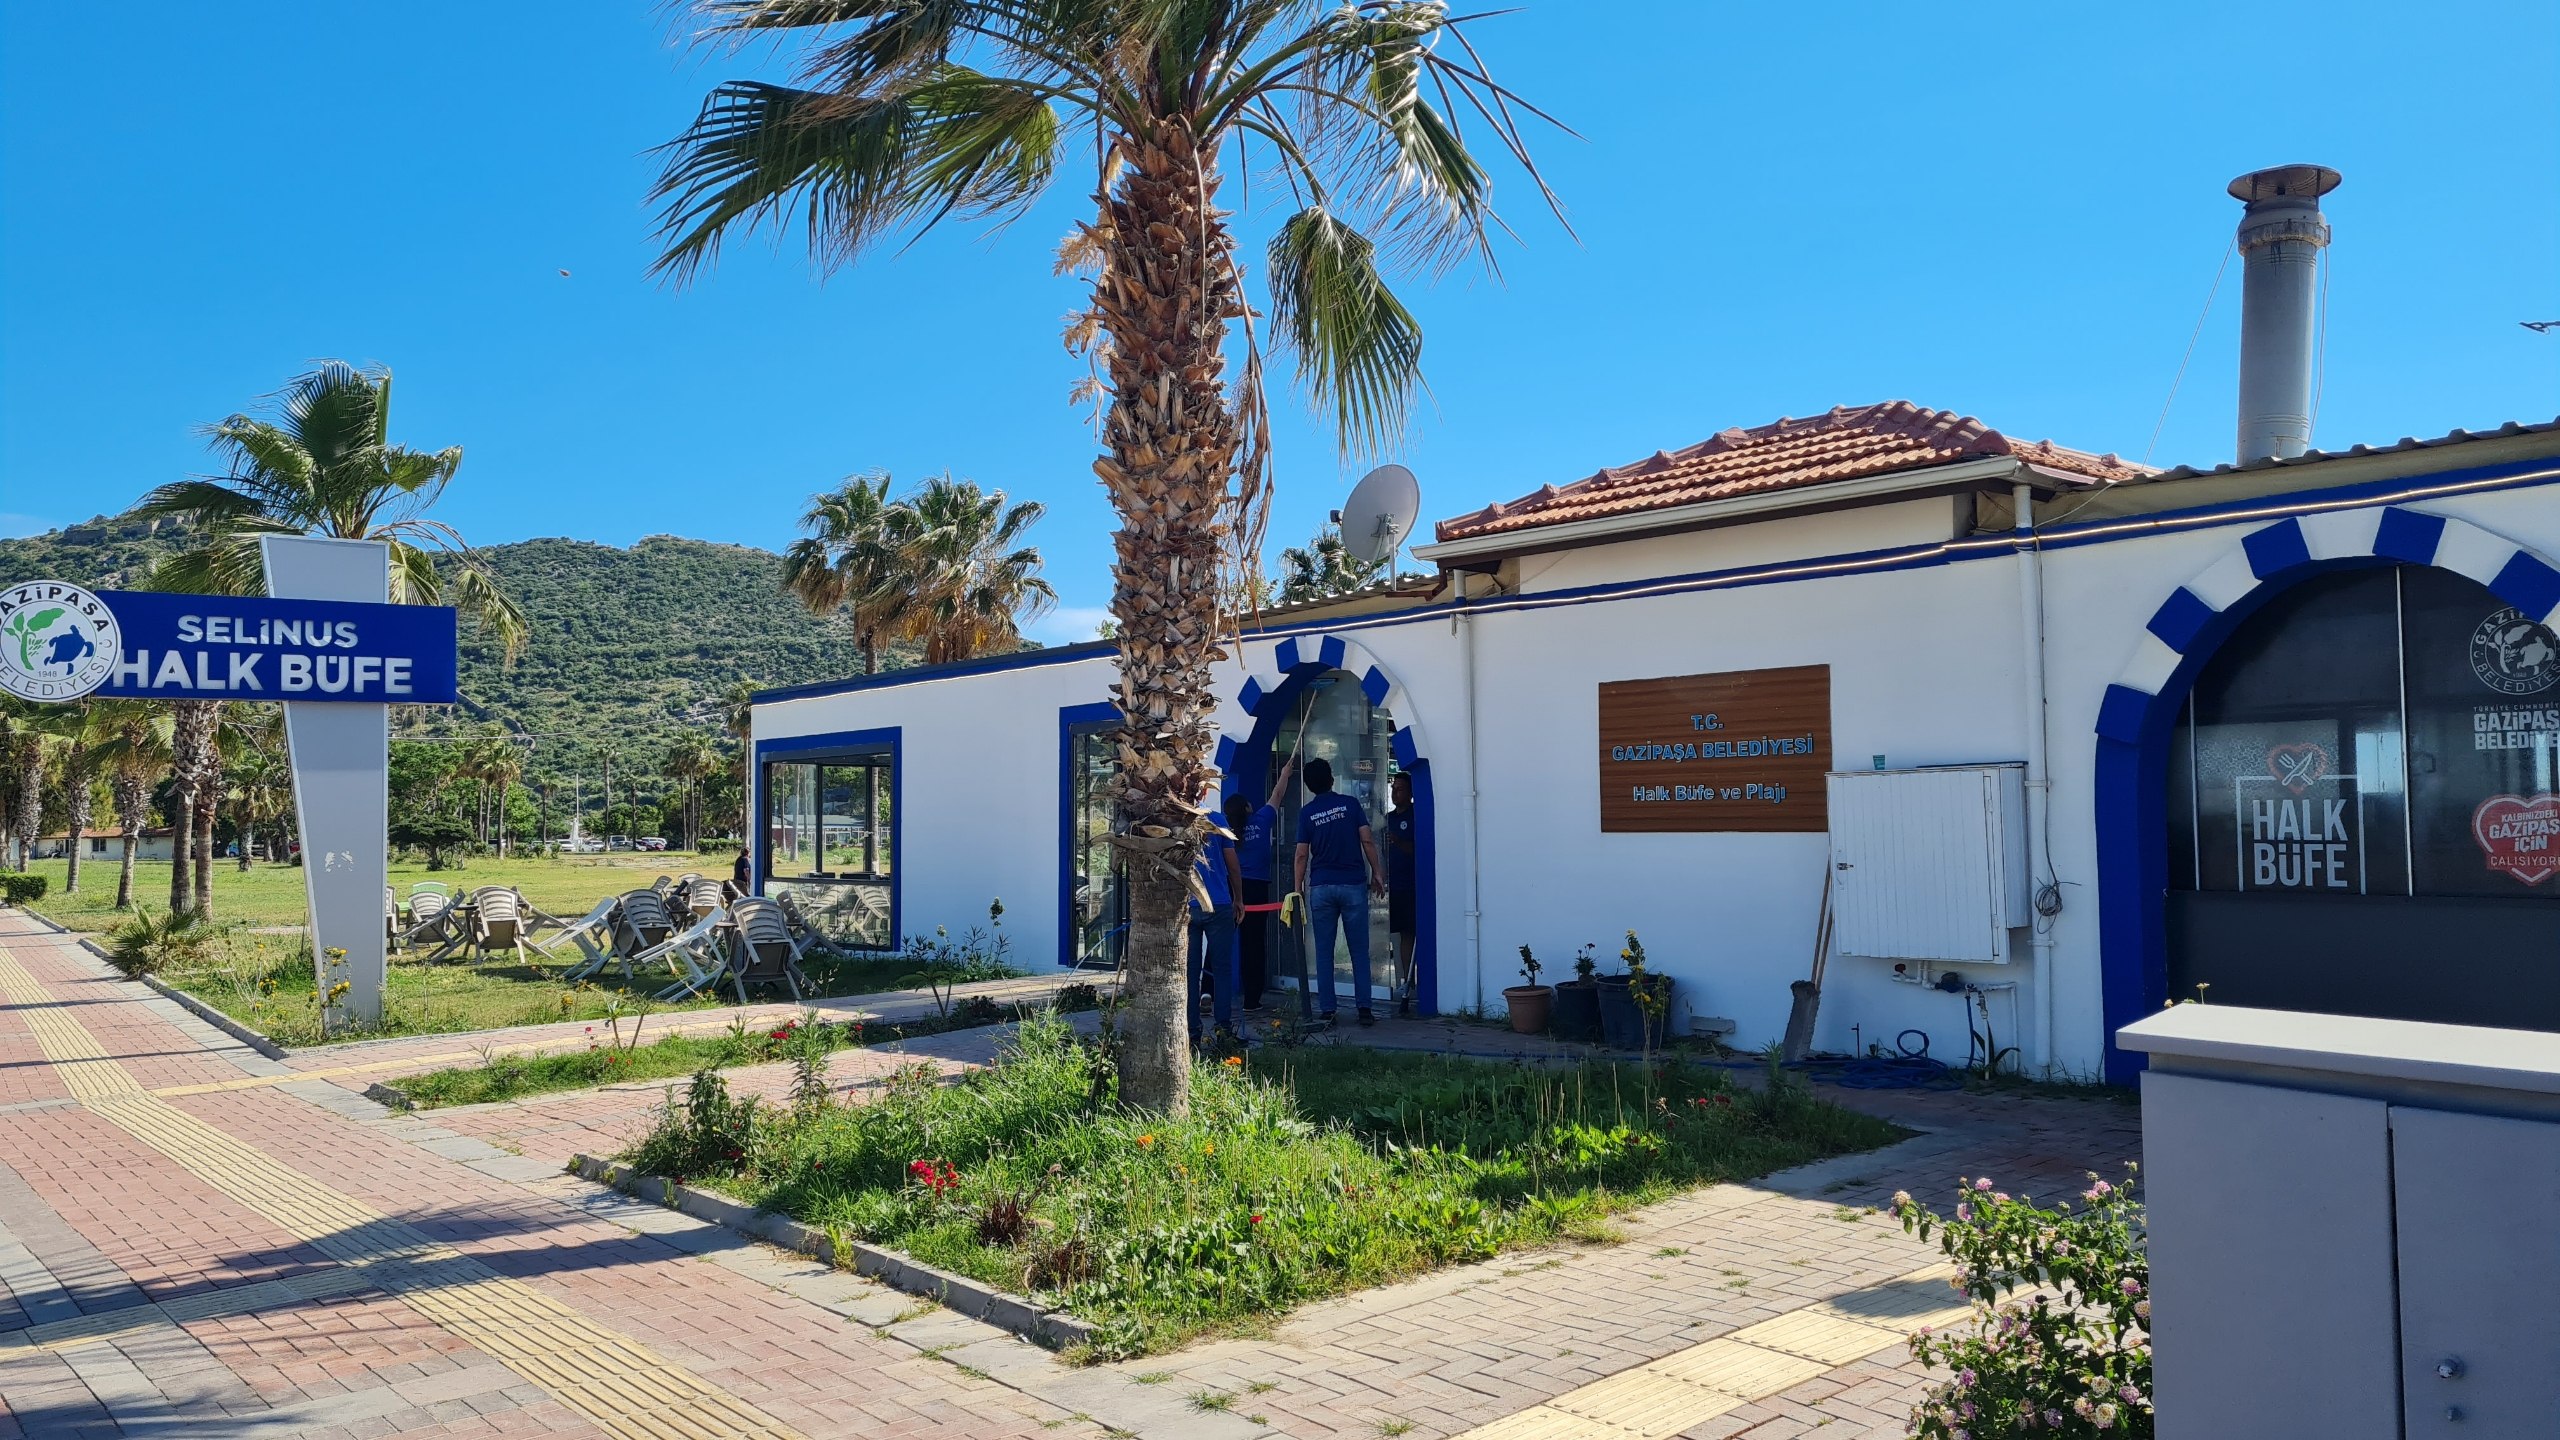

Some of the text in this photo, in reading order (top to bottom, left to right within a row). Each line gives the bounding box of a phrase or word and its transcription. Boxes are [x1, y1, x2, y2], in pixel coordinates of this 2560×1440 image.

[0, 655, 110, 697] ELEDİYESİ
[37, 670, 58, 678] 1948
[112, 648, 413, 694] HALK BÜFE
[2476, 660, 2560, 692] BELEDİYES
[1690, 713, 1724, 730] T.C.
[2473, 710, 2560, 732] GAZİPAŞ
[1612, 733, 1813, 763] GAZİPAŞA BELEDİYESİ
[1633, 782, 1786, 803] Halk Büfe ve Plajı
[2252, 799, 2348, 841] HALK
[2489, 818, 2560, 839] GAZİPAŞ
[2253, 843, 2348, 888] BÜFE
[2490, 856, 2560, 867] ÇALIŞIYOR
